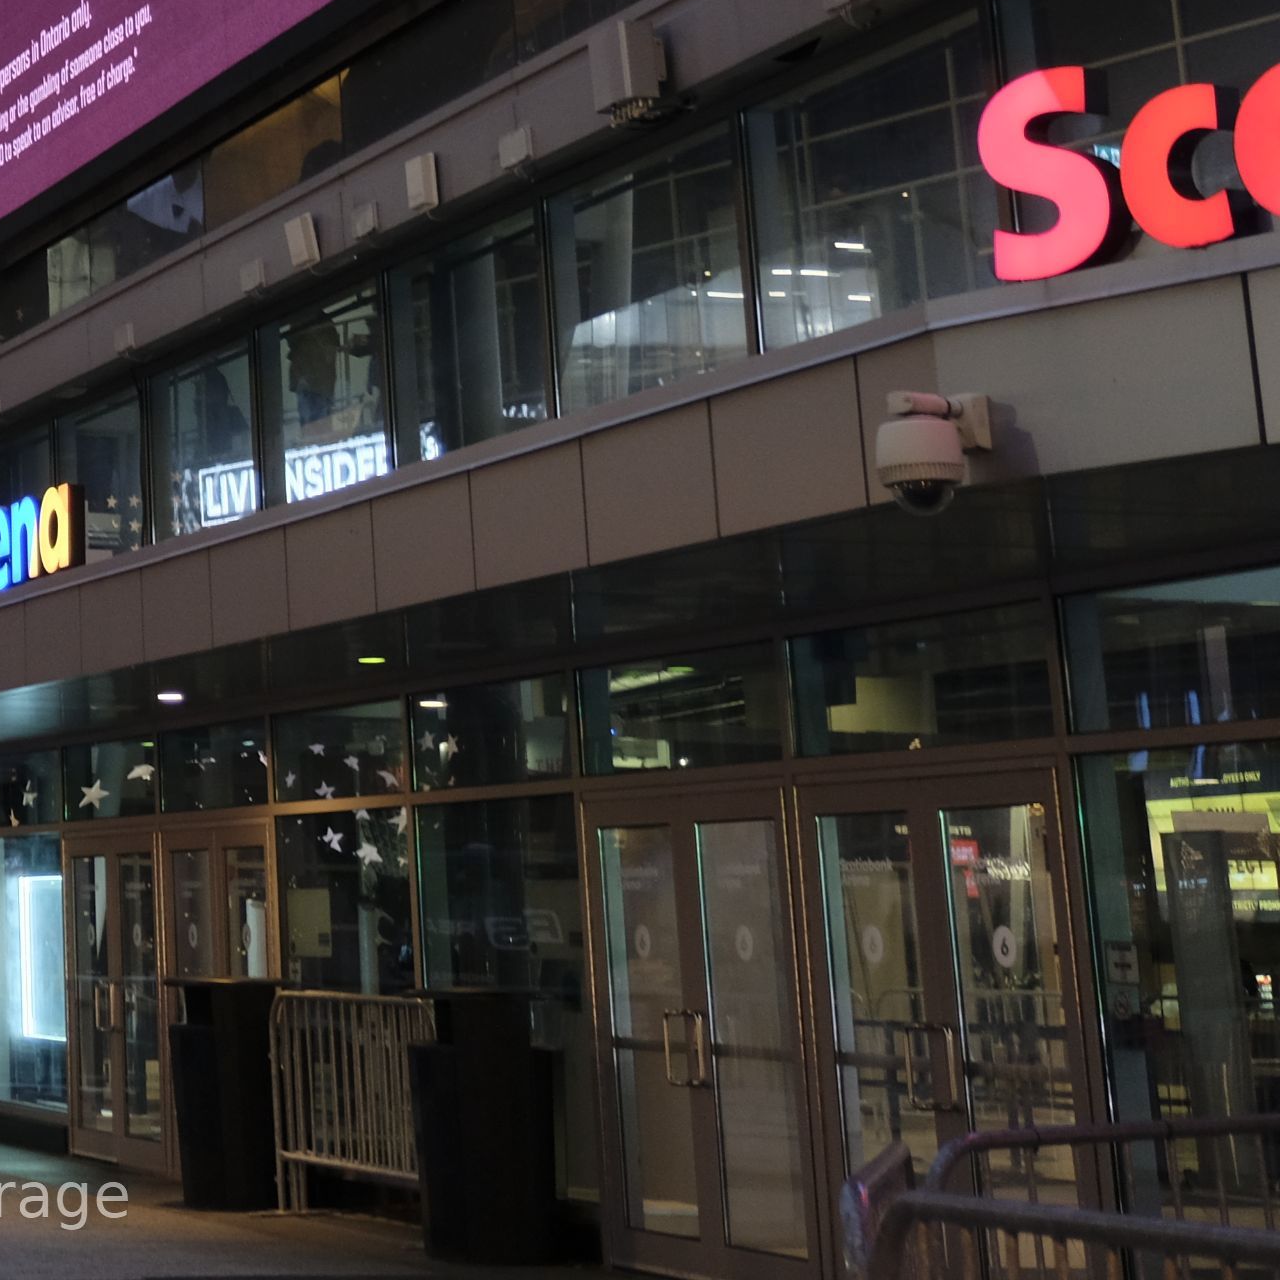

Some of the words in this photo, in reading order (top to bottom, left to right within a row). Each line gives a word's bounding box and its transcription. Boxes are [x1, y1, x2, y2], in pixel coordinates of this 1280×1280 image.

[0, 48, 31, 95] persons
[31, 39, 40, 64] in
[40, 15, 71, 58] Ontario
[10, 104, 17, 124] or
[17, 94, 29, 118] the
[30, 72, 60, 113] gambling
[61, 59, 69, 85] of
[70, 39, 103, 79] someone
[103, 23, 124, 55] close
[125, 15, 134, 38] to
[4, 141, 13, 163] to
[13, 123, 33, 159] speak
[33, 118, 42, 142] to
[42, 113, 51, 137] an
[80, 82, 96, 109] free
[96, 70, 107, 97] of
[978, 63, 1280, 281] Sc
